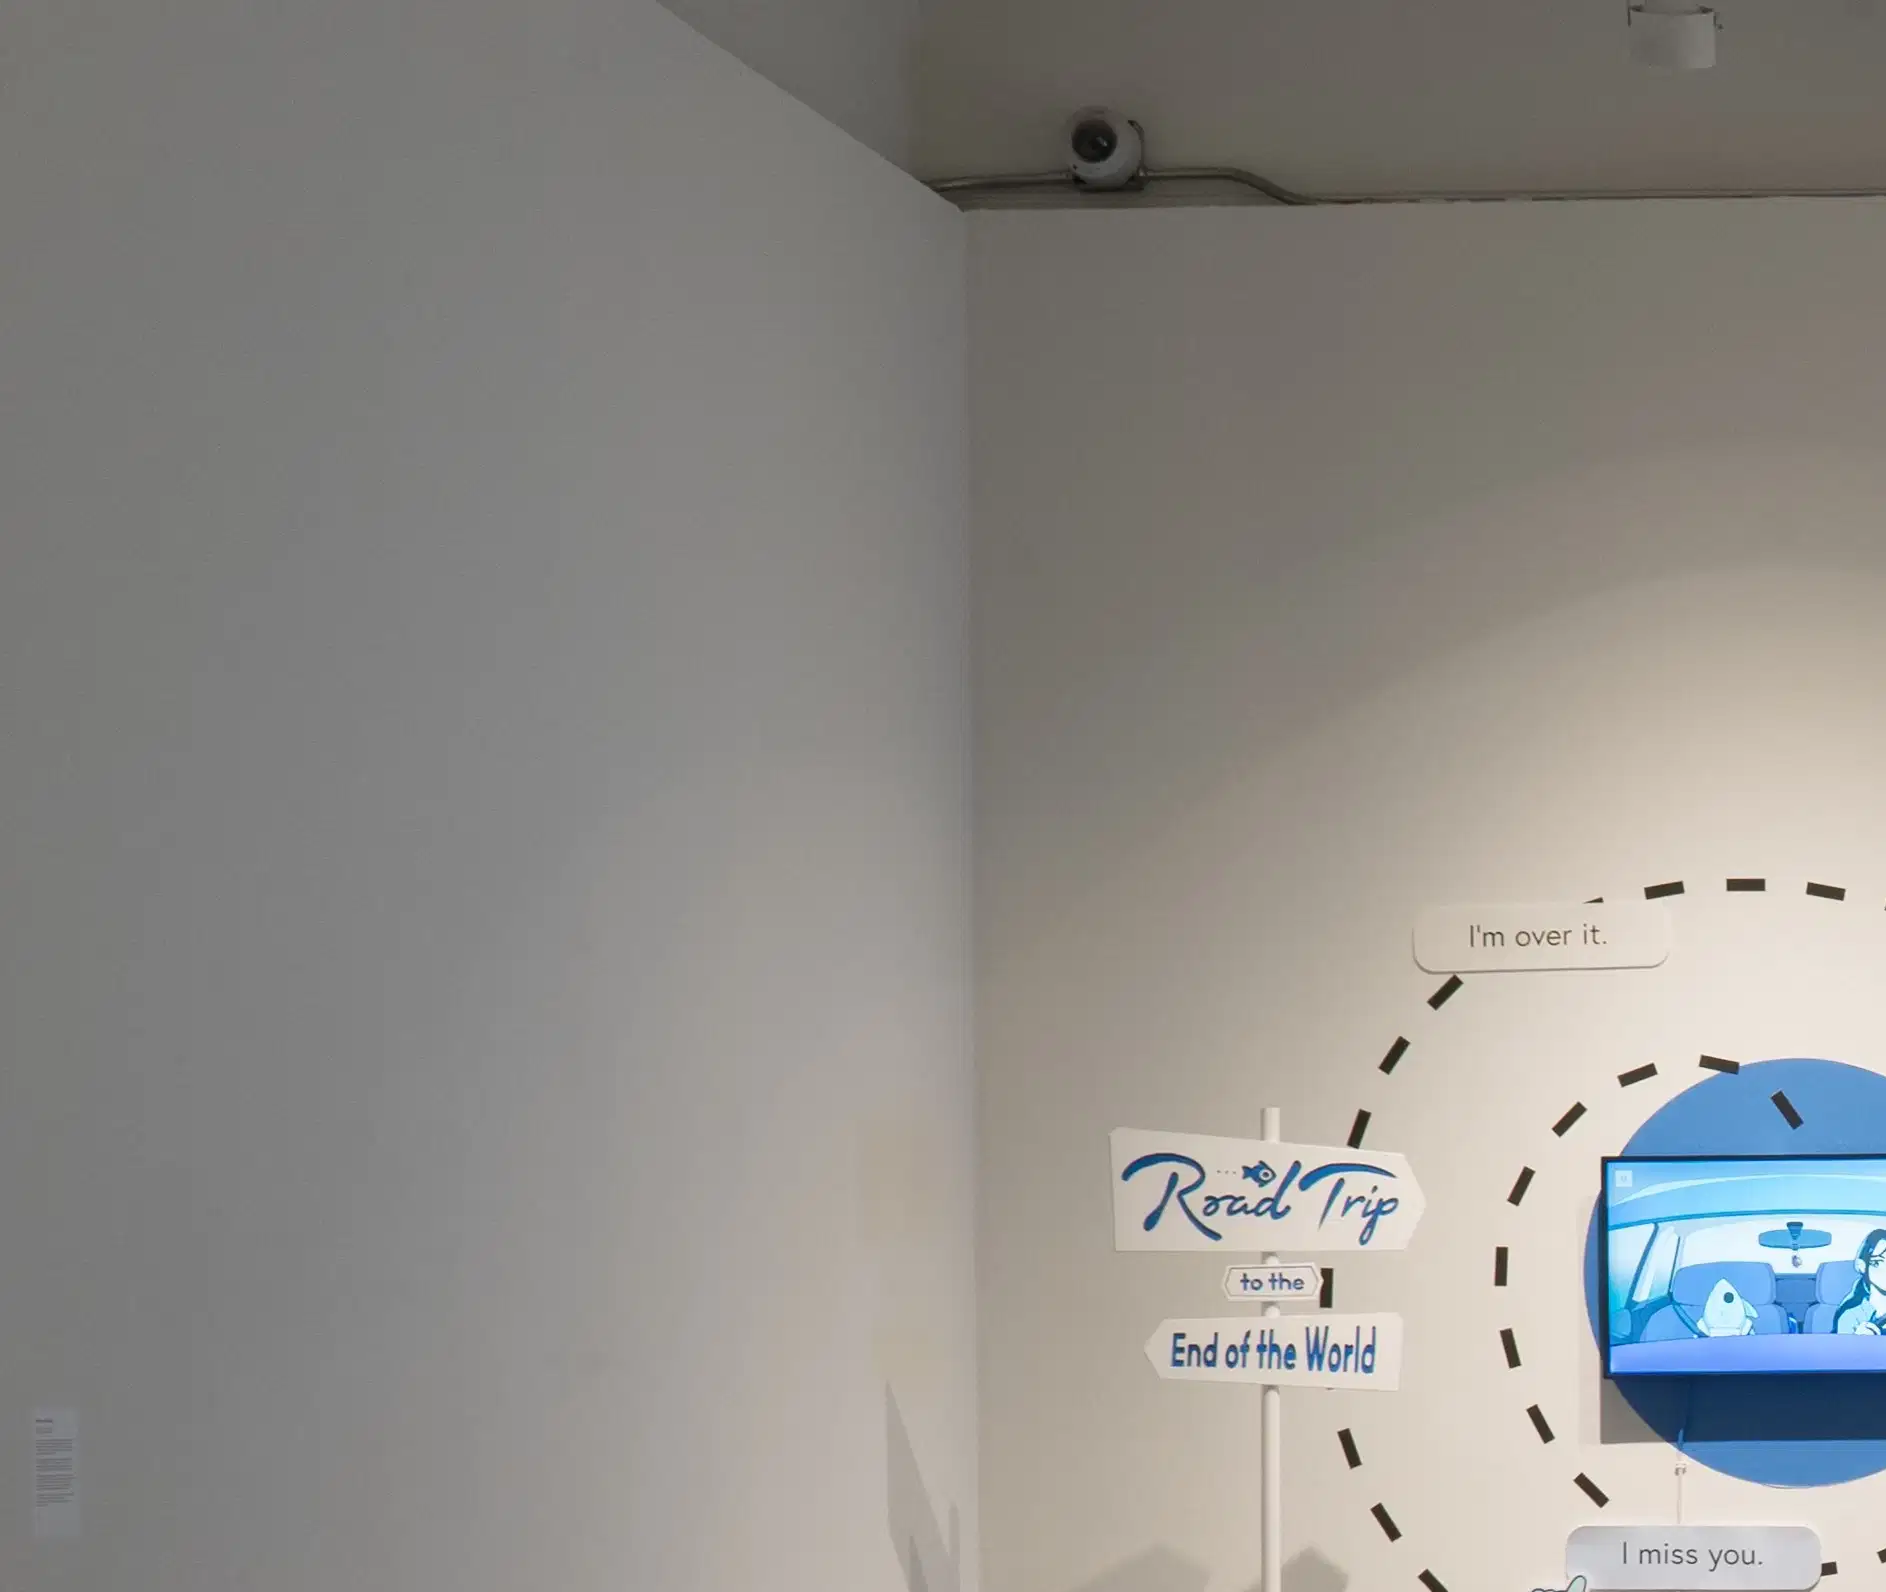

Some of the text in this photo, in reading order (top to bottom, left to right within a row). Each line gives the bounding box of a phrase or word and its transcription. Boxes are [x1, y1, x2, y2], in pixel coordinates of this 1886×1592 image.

[1468, 922, 1608, 948] I'm over it.
[1121, 1152, 1399, 1246] Road Trip
[1240, 1272, 1306, 1291] to the
[1170, 1325, 1378, 1375] End of the World
[1621, 1540, 1764, 1572] I miss you.
